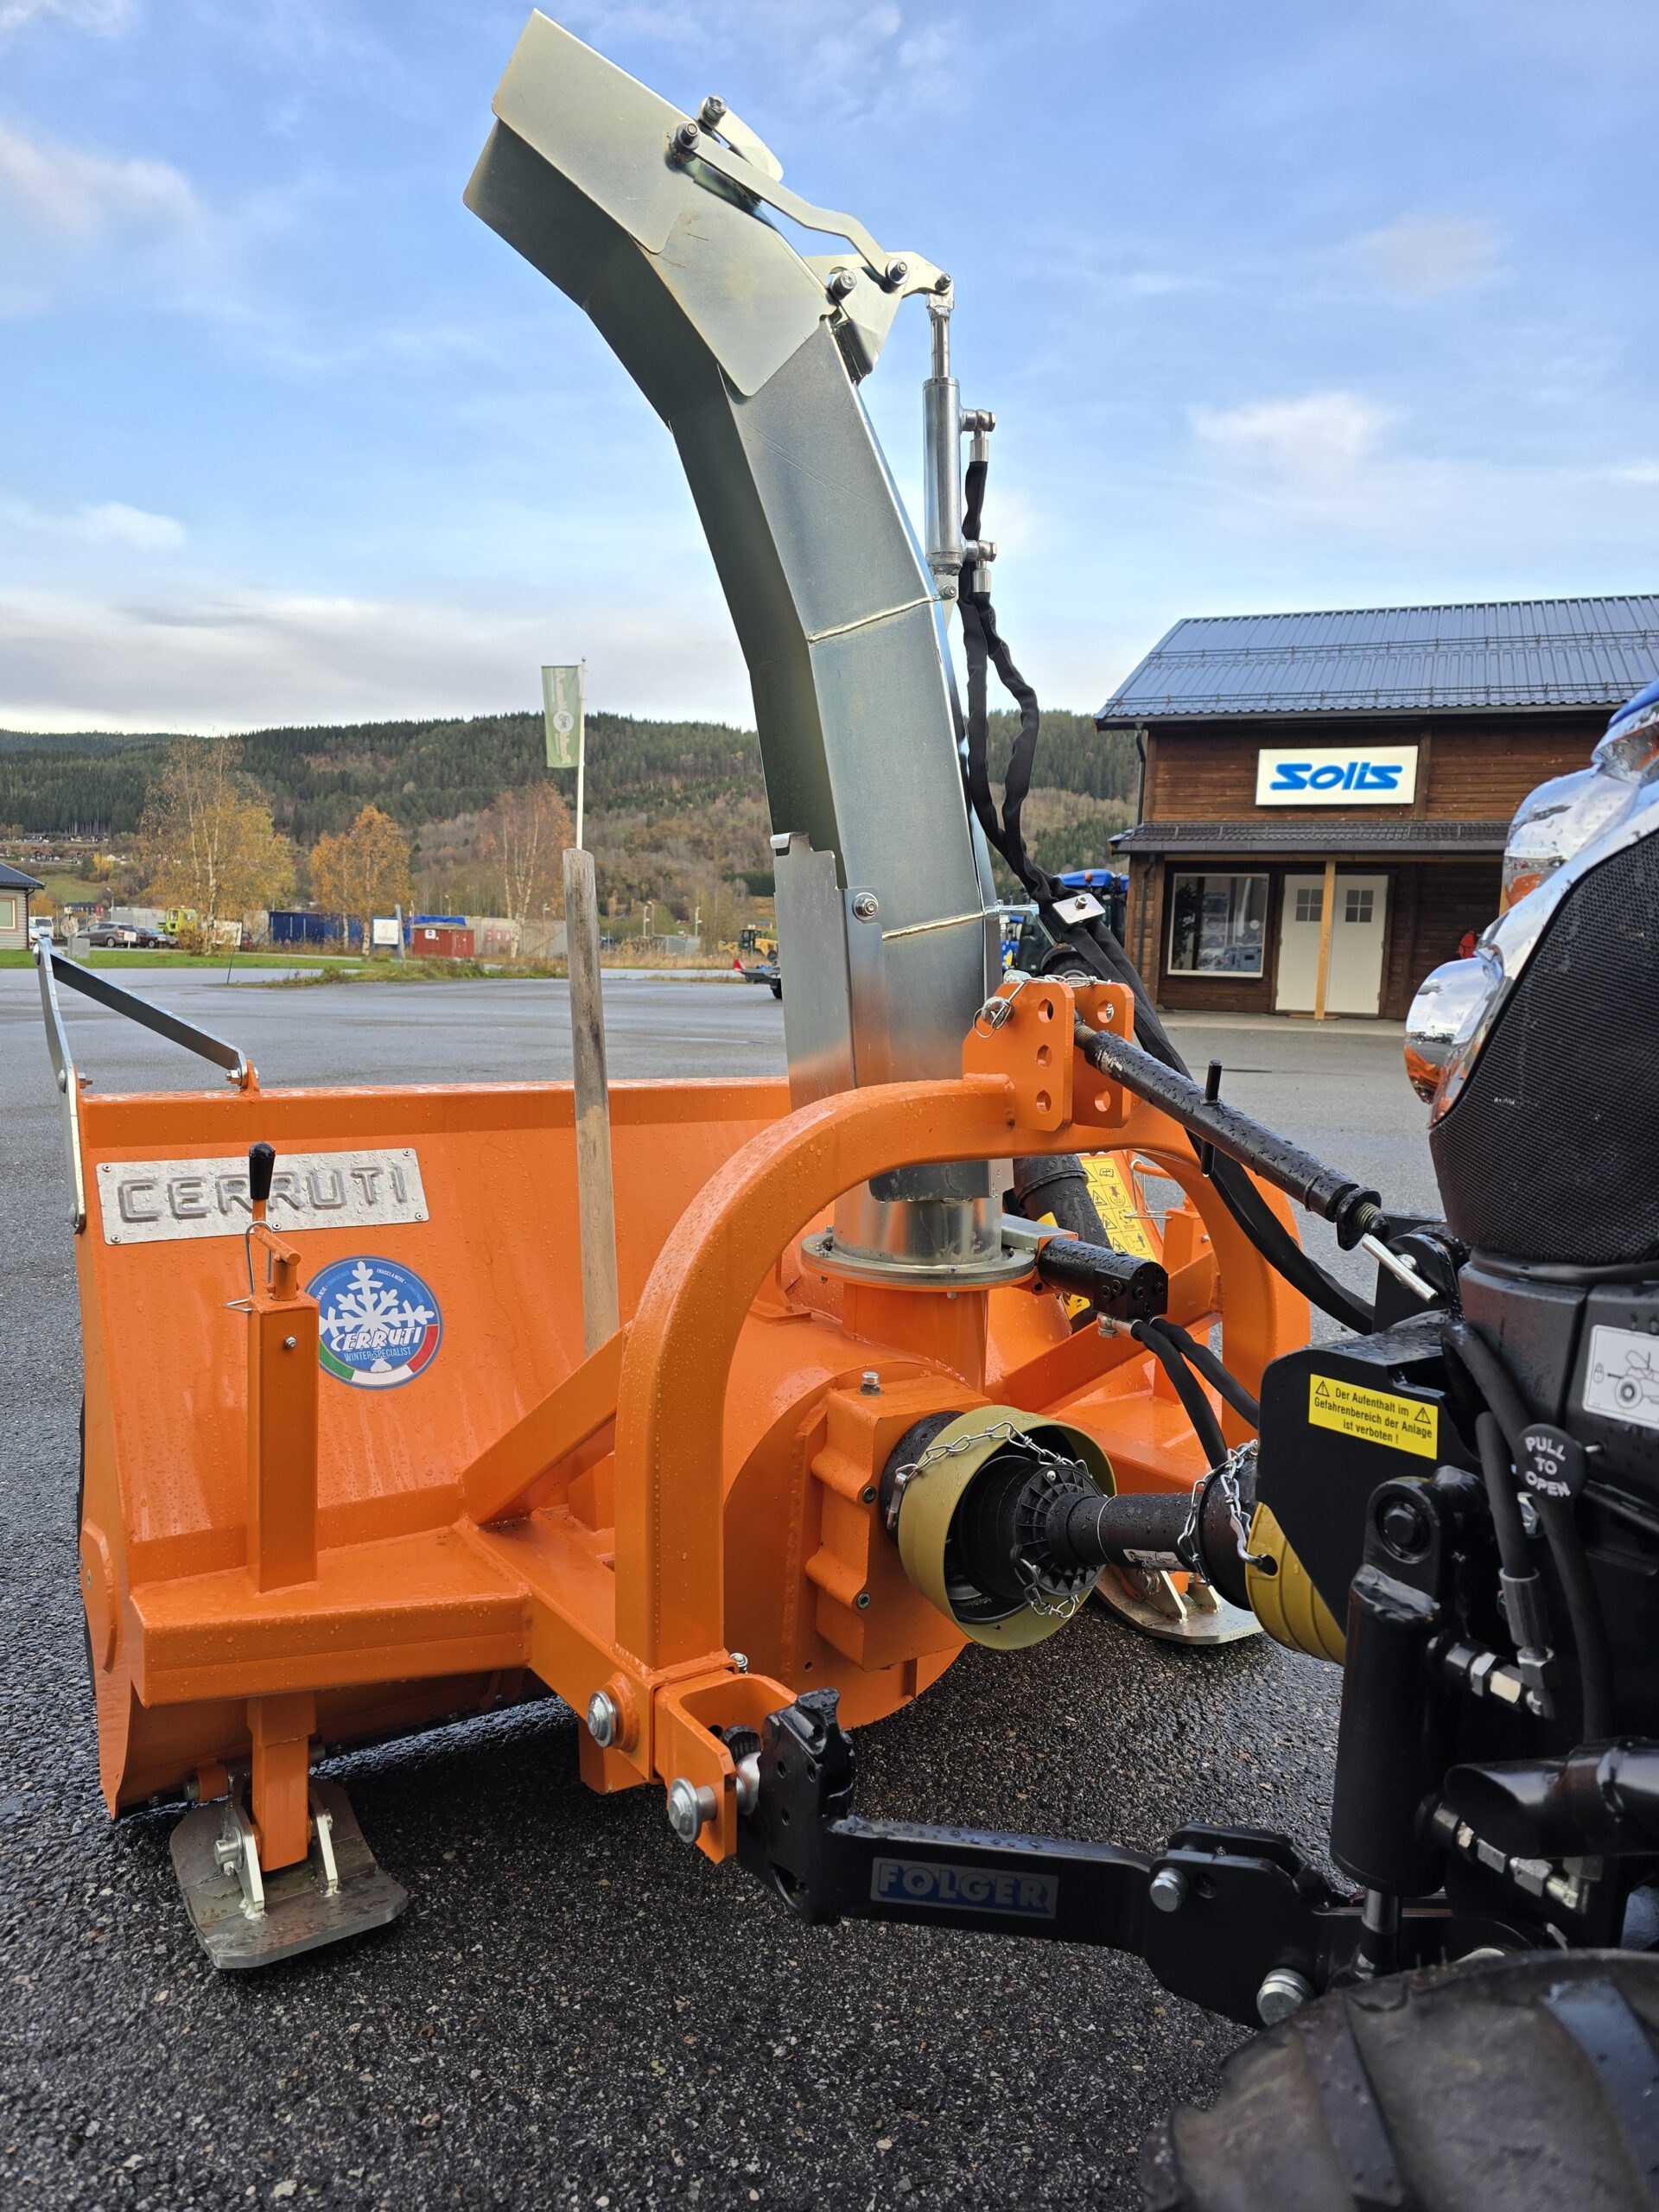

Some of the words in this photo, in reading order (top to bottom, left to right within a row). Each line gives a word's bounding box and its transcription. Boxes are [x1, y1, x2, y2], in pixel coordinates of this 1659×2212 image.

[117, 1165, 409, 1224] CERRUTI
[330, 1326, 423, 1351] CERRUTI
[344, 1351, 372, 1363] WINTER
[372, 1346, 412, 1359] SPECIALIST
[1335, 1387, 1350, 1401] Der
[1351, 1392, 1395, 1414] Aufenthalt
[1398, 1404, 1409, 1417] im
[1314, 1397, 1382, 1425] Gefahrenbereich
[1384, 1416, 1399, 1430] der
[1402, 1421, 1433, 1439] Anlage
[1343, 1419, 1353, 1431] ist
[1356, 1422, 1393, 1442] verboten
[1524, 1436, 1567, 1462] PULL
[1534, 1456, 1558, 1476] TO
[1524, 1471, 1571, 1497] OPEN
[877, 1863, 1049, 1912] FOLGER
